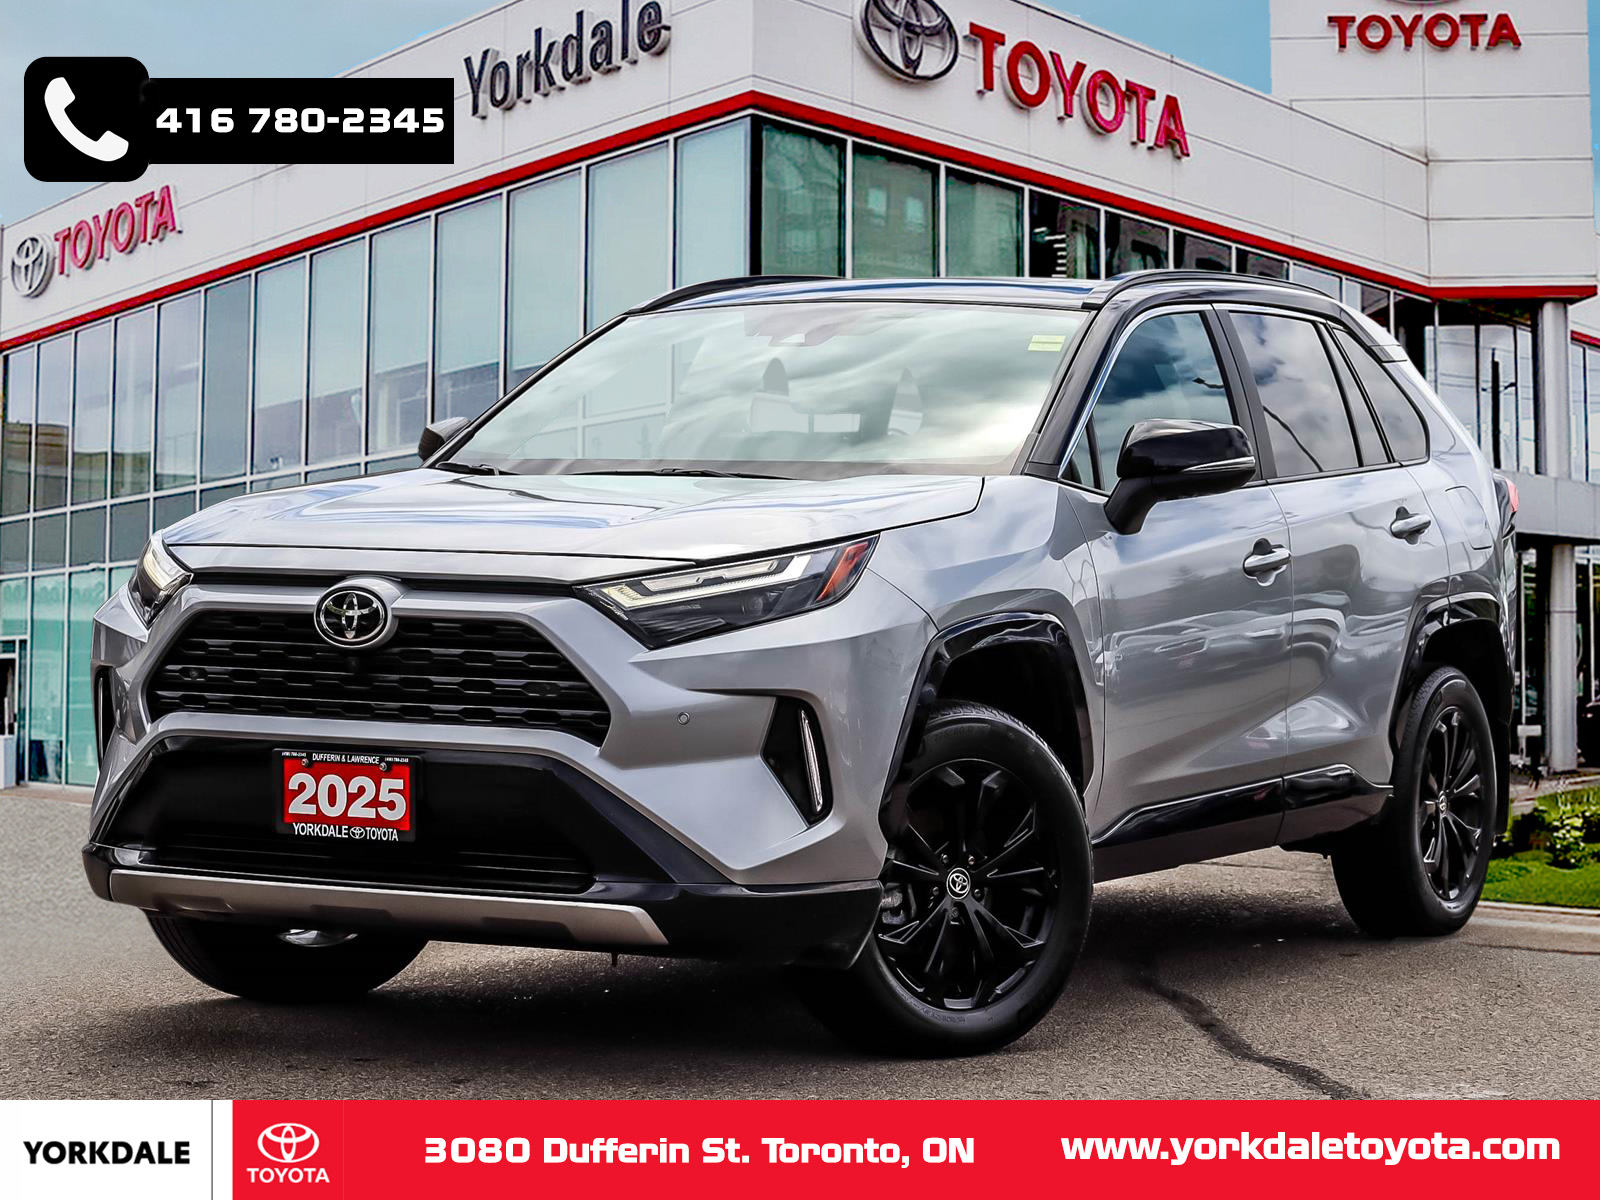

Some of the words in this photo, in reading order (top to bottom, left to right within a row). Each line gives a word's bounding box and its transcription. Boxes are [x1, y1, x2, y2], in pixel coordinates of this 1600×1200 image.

[1328, 12, 1522, 51] TOYOTA
[463, 0, 671, 119] Yorkdale
[968, 21, 1191, 158] TOYOTA
[53, 185, 178, 276] TOYOTA
[312, 753, 340, 763] DUFFERIN
[341, 754, 346, 763] &
[347, 754, 380, 765] LAWRENCE
[288, 772, 407, 821] 2025
[292, 822, 349, 838] YORKDALE
[365, 827, 399, 842] TOYOTA
